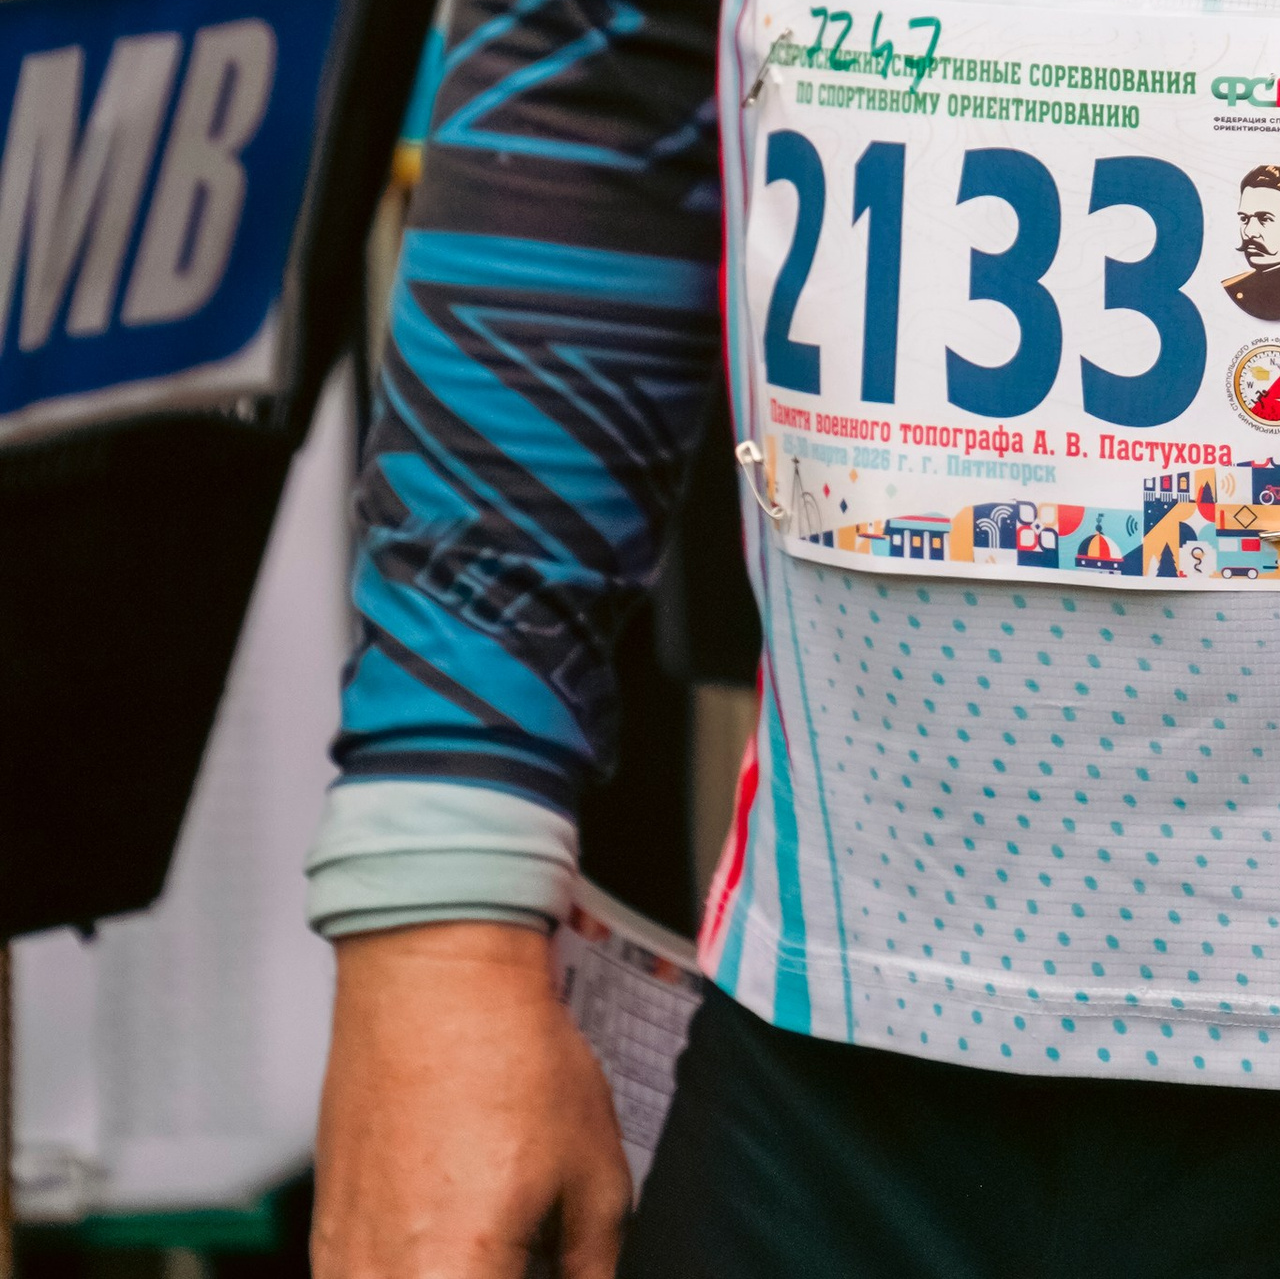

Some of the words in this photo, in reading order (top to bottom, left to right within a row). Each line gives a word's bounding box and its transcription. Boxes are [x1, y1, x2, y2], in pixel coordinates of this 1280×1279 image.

[891, 53, 1022, 86] СПРТИВНЫЕ
[1029, 63, 1197, 95] СОРЕВНОВАНИЯ
[796, 80, 814, 105] ПО
[818, 83, 941, 116] СПОРТИВНОМУ
[947, 93, 1141, 129] ОРИЕНТИРОВАНИЮ
[1213, 116, 1267, 124] ФЕДЕРАЦИЯ
[763, 127, 1208, 428] 2133
[770, 398, 811, 430] Памяти
[816, 412, 892, 443] военного
[900, 422, 1024, 458] топографа
[1033, 429, 1055, 456] А.
[1065, 431, 1088, 458] В.
[1099, 434, 1233, 470] Пастухова
[947, 454, 1057, 486] Пятигорск
